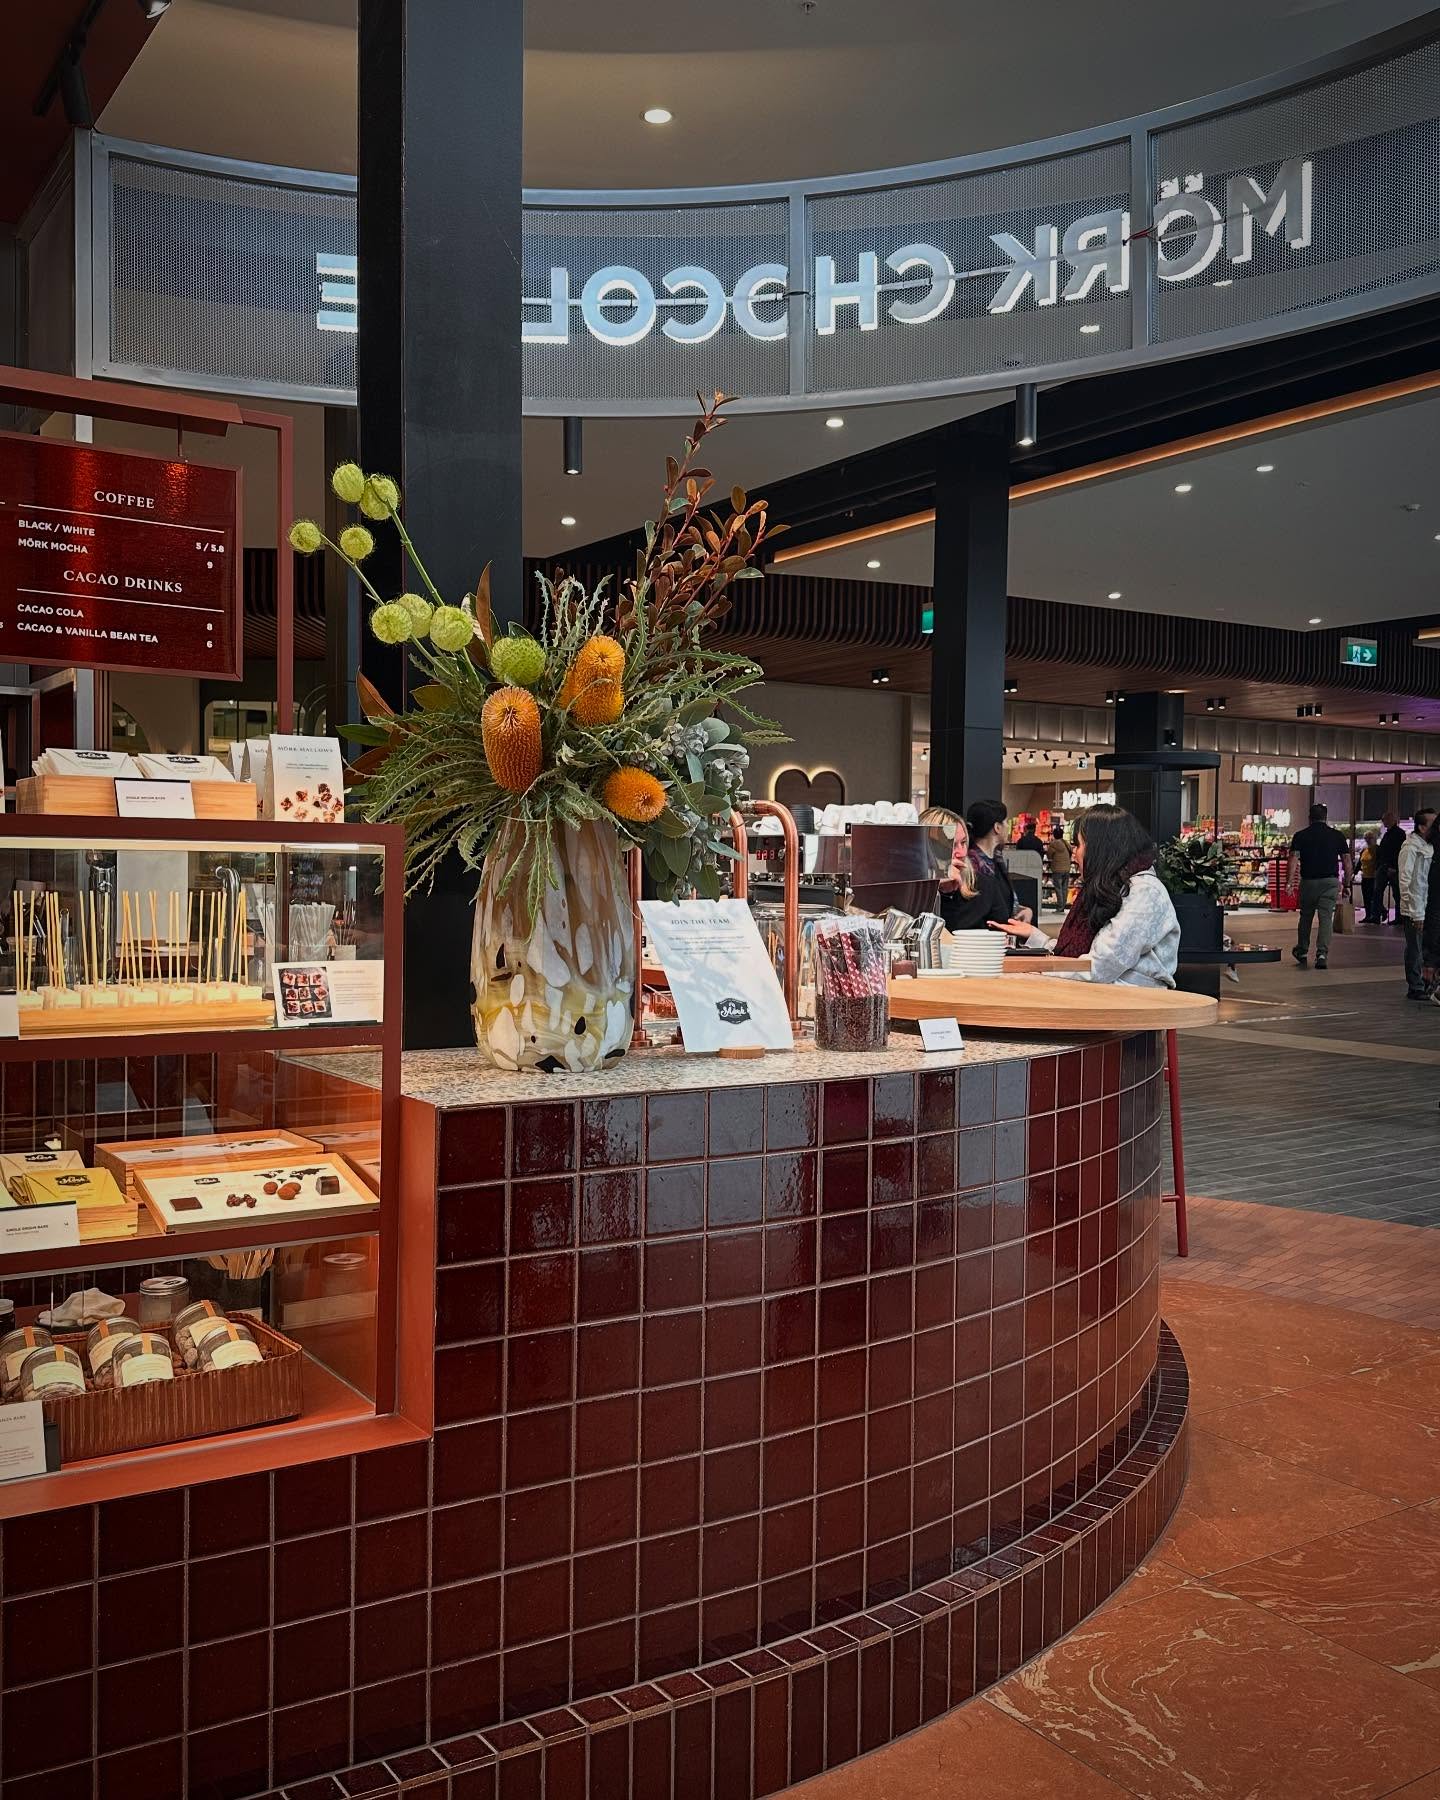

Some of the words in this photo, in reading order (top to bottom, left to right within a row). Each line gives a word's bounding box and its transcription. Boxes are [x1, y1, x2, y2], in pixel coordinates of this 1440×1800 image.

[94, 491, 154, 508] COFFEE
[19, 520, 52, 531] BLACK
[54, 524, 60, 532] /
[62, 525, 95, 536] WHITE
[18, 538, 48, 549] MÖRK
[51, 542, 88, 554] MOCHA
[196, 542, 201, 550] 5
[203, 543, 209, 551] /
[211, 544, 224, 552] 5.8
[64, 570, 118, 585] CACAO
[125, 576, 182, 592] DRINKS
[17, 604, 53, 614] CACAO
[56, 608, 84, 618] COLA
[17, 623, 53, 633] CACAO
[56, 626, 62, 634] &
[65, 627, 107, 638] VANILLA
[110, 631, 137, 641] BEAN
[139, 634, 158, 643] TEA
[671, 918, 689, 926] JOIN
[691, 918, 707, 926] THE
[709, 917, 731, 925] TEAM
